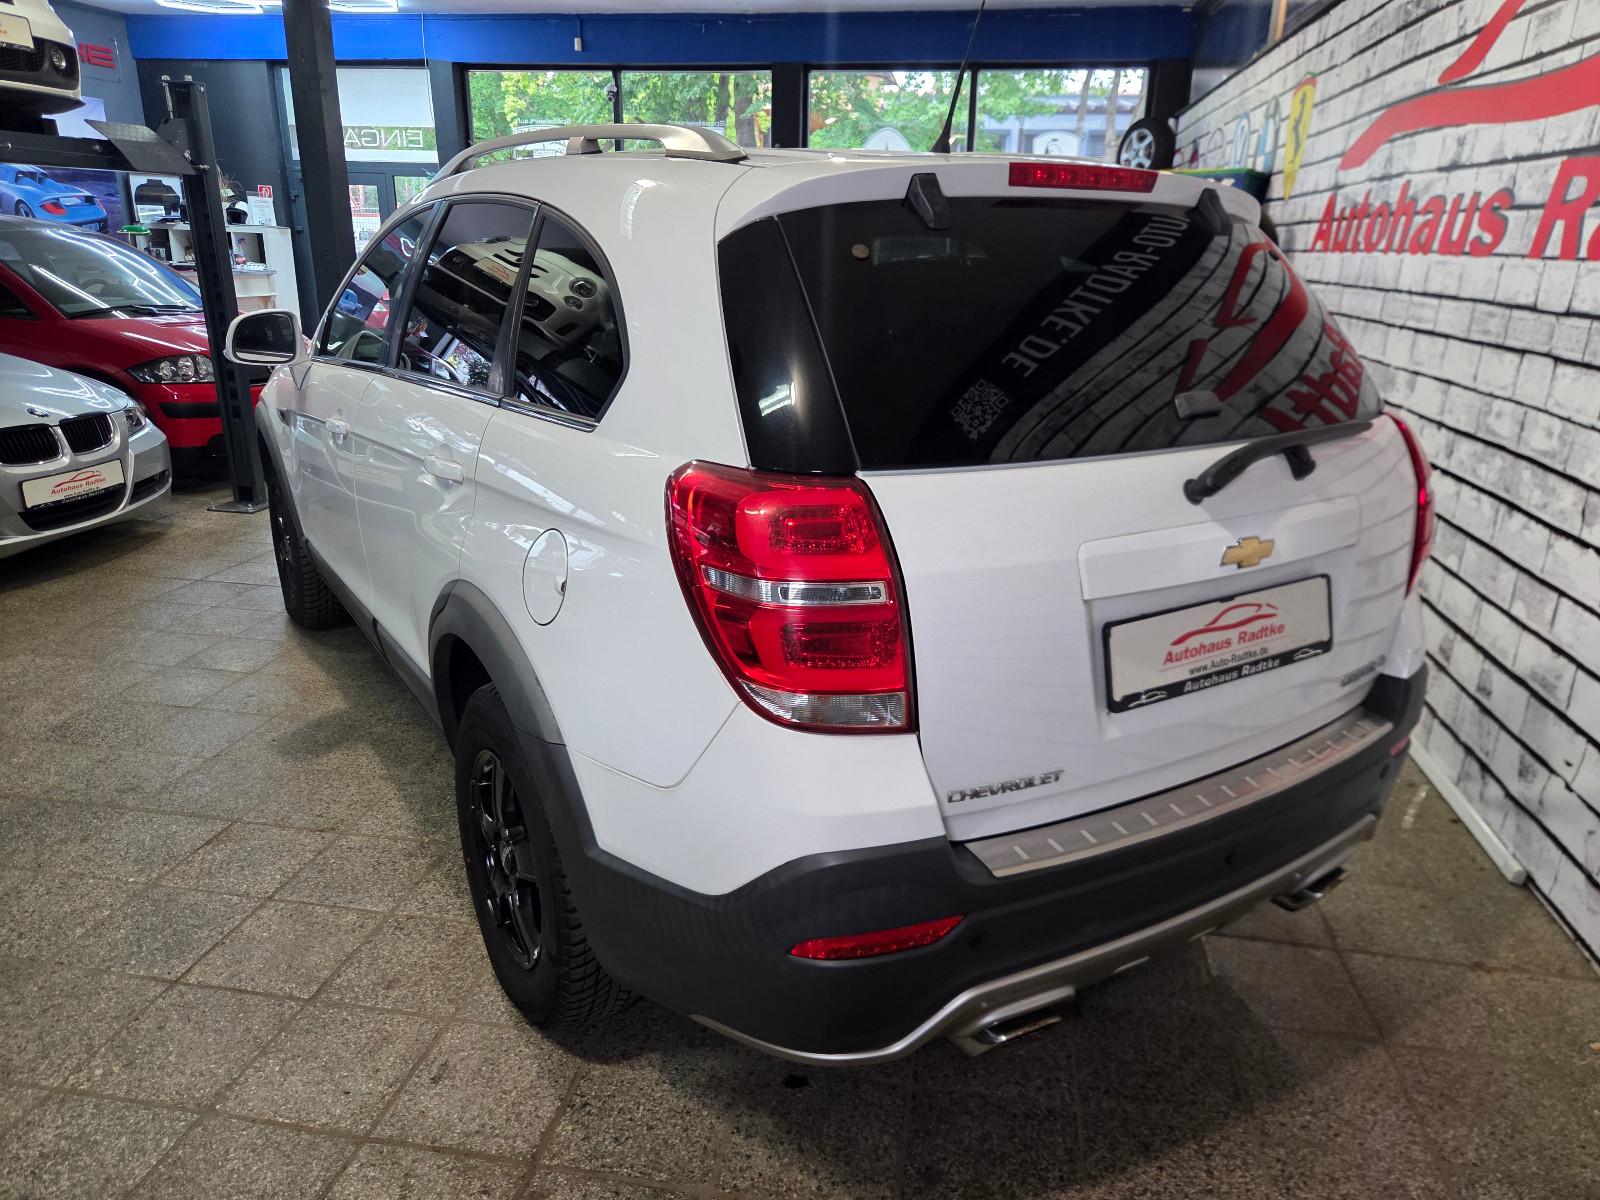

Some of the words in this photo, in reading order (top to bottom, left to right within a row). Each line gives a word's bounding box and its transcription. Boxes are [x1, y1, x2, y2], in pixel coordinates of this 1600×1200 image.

[1310, 179, 1515, 257] Autohaus
[1526, 155, 1600, 261] R
[1163, 638, 1232, 665] Autohaus
[1237, 623, 1286, 645] Radtke
[1188, 646, 1269, 676] www.Auto-Radtke.de
[1183, 670, 1239, 693] Autohaus
[1241, 658, 1280, 677] Radtke
[947, 769, 1065, 803] CHEVROLET
